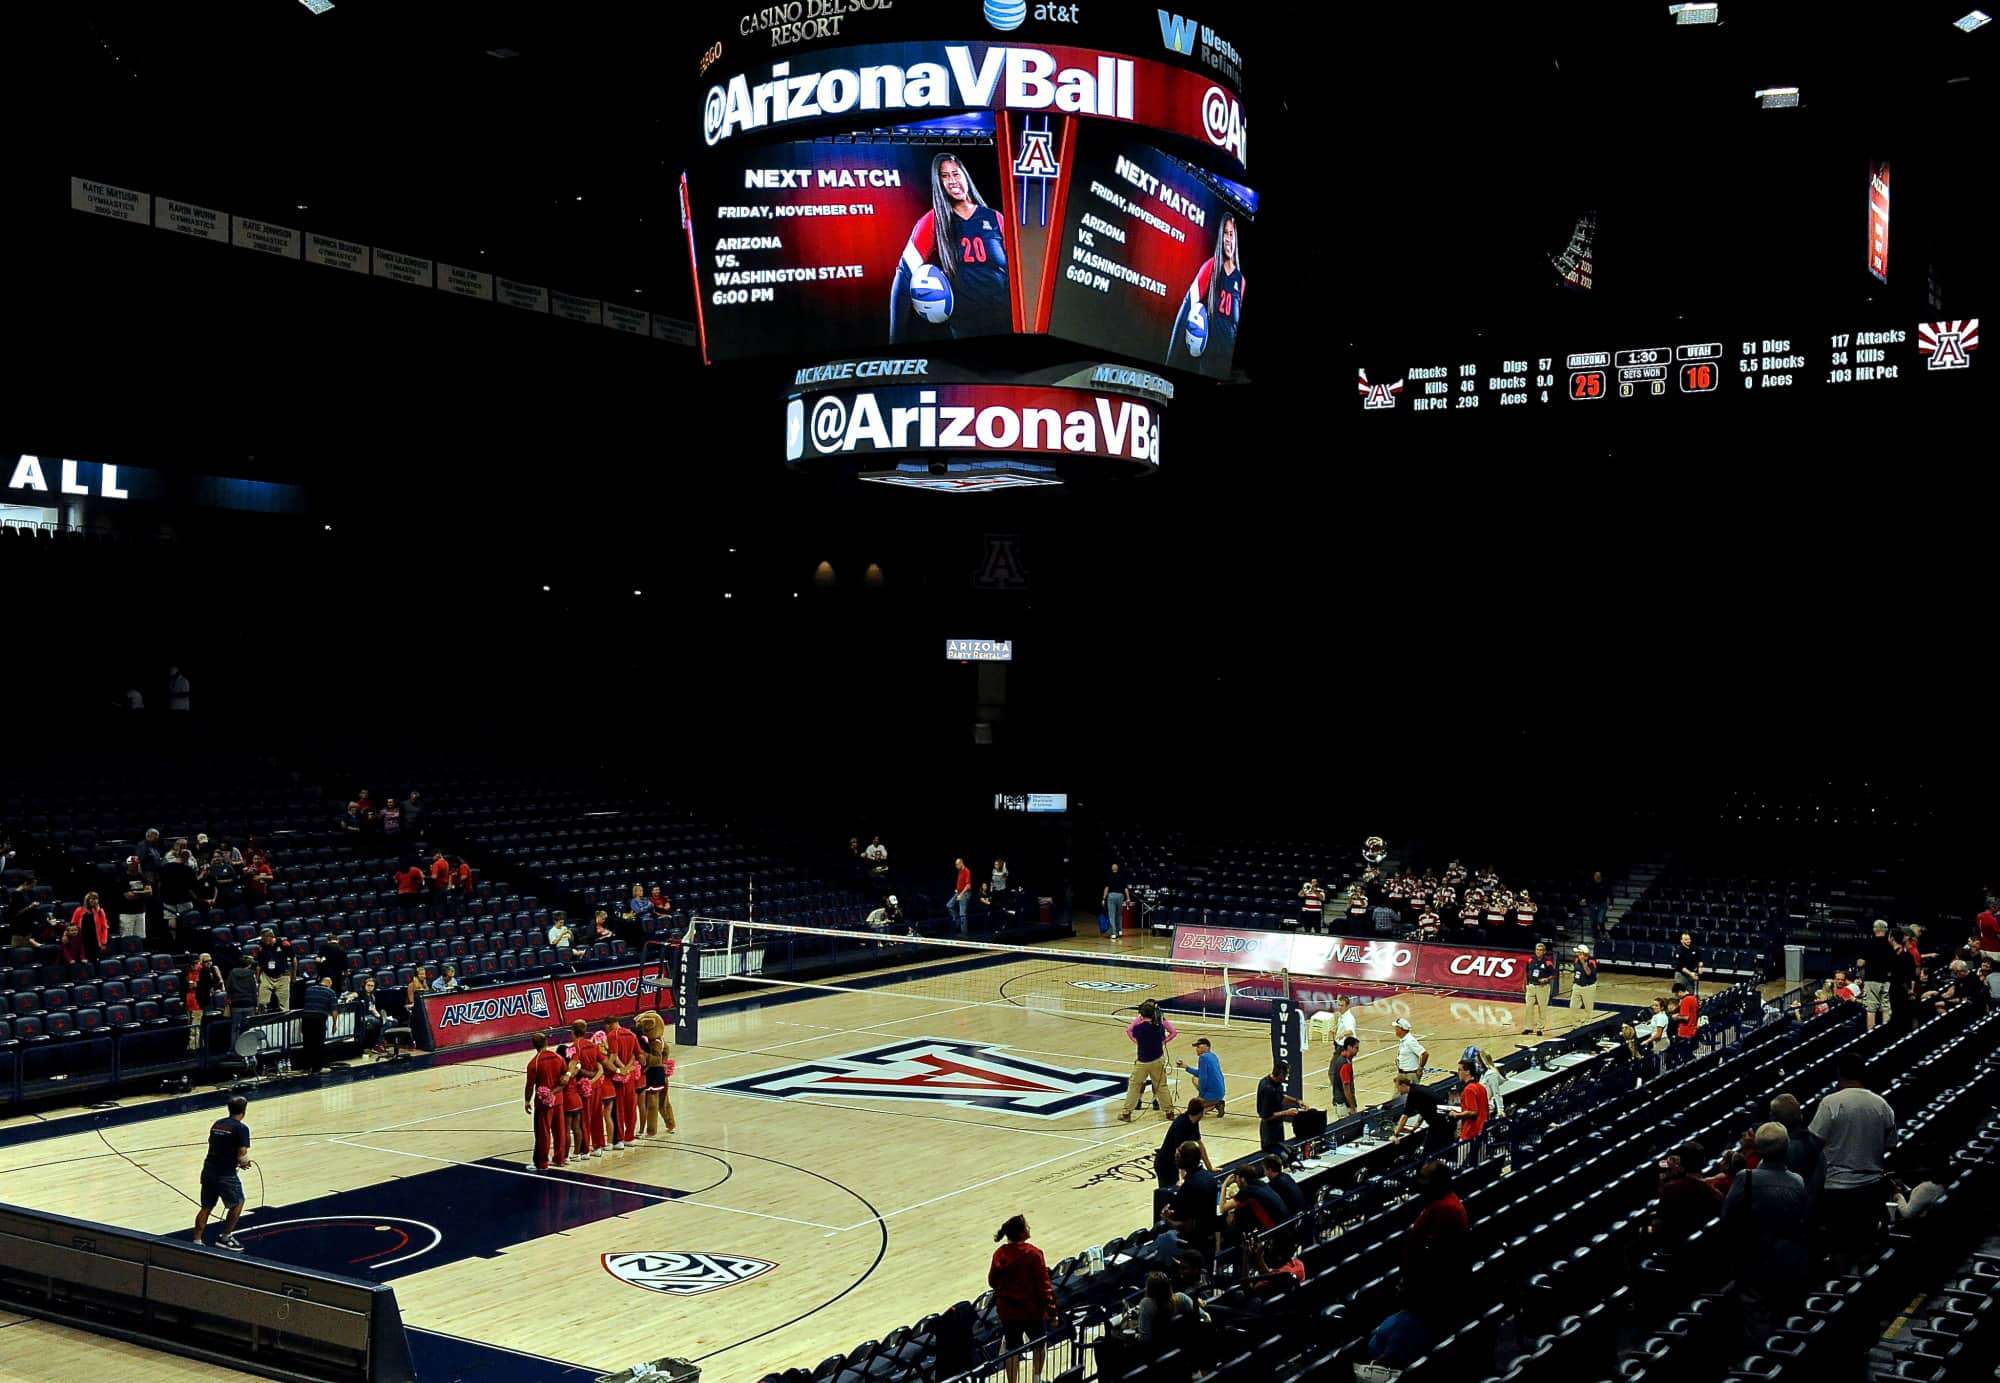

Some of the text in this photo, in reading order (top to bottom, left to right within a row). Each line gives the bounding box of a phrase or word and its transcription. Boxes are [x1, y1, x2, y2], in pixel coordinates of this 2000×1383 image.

[740, 0, 803, 36] CASINO
[1034, 2, 1080, 25] at&t
[771, 15, 844, 47] RESORT
[704, 46, 1134, 146] @ArizonaVBall
[745, 169, 902, 189] NEXT MATCH
[1114, 154, 1206, 227] NEXT MATCH
[717, 203, 874, 220] FRIDAY, NOVEMBER 6TH
[1090, 180, 1128, 213] FRIDAY,
[1128, 202, 1171, 235] NOVEMBER
[1081, 212, 1126, 244] ARIZONA
[716, 236, 782, 251] ARIZONA
[1077, 228, 1095, 248] VS.
[960, 236, 987, 263] 20
[715, 254, 740, 268] VS.
[714, 265, 864, 286] WASHINGTON STATE
[1066, 264, 1111, 293] 6:00 PM
[1072, 246, 1167, 297] WASHINGTON STATE
[713, 287, 774, 305] 6:00 PM
[1742, 339, 1791, 355] 51 Digs
[1831, 330, 1906, 348] 117 Attacks
[1570, 354, 1606, 366] ARIZONA
[1628, 350, 1658, 364] 1:30
[1687, 345, 1711, 357] UTAH
[1832, 349, 1885, 366] 34 Kills
[795, 358, 928, 384] MCKALE CENTER
[1408, 363, 1477, 380] Attacks 116
[1503, 358, 1552, 373] Digs 57
[1643, 368, 1661, 378] WON
[1739, 355, 1805, 373] 5.5 Blocks
[1855, 366, 1874, 381] Hit
[1876, 365, 1898, 380] Pct
[1424, 379, 1475, 394] Kills 46
[1489, 375, 1526, 390] Blocks
[1575, 373, 1600, 398] 25
[1687, 366, 1710, 389] 16
[1761, 374, 1793, 388] Aces
[1500, 390, 1549, 406] Aces 4
[948, 640, 1010, 652] ARIZONA
[1449, 954, 1518, 978] CATS
[440, 995, 527, 1028] ARIZONA
